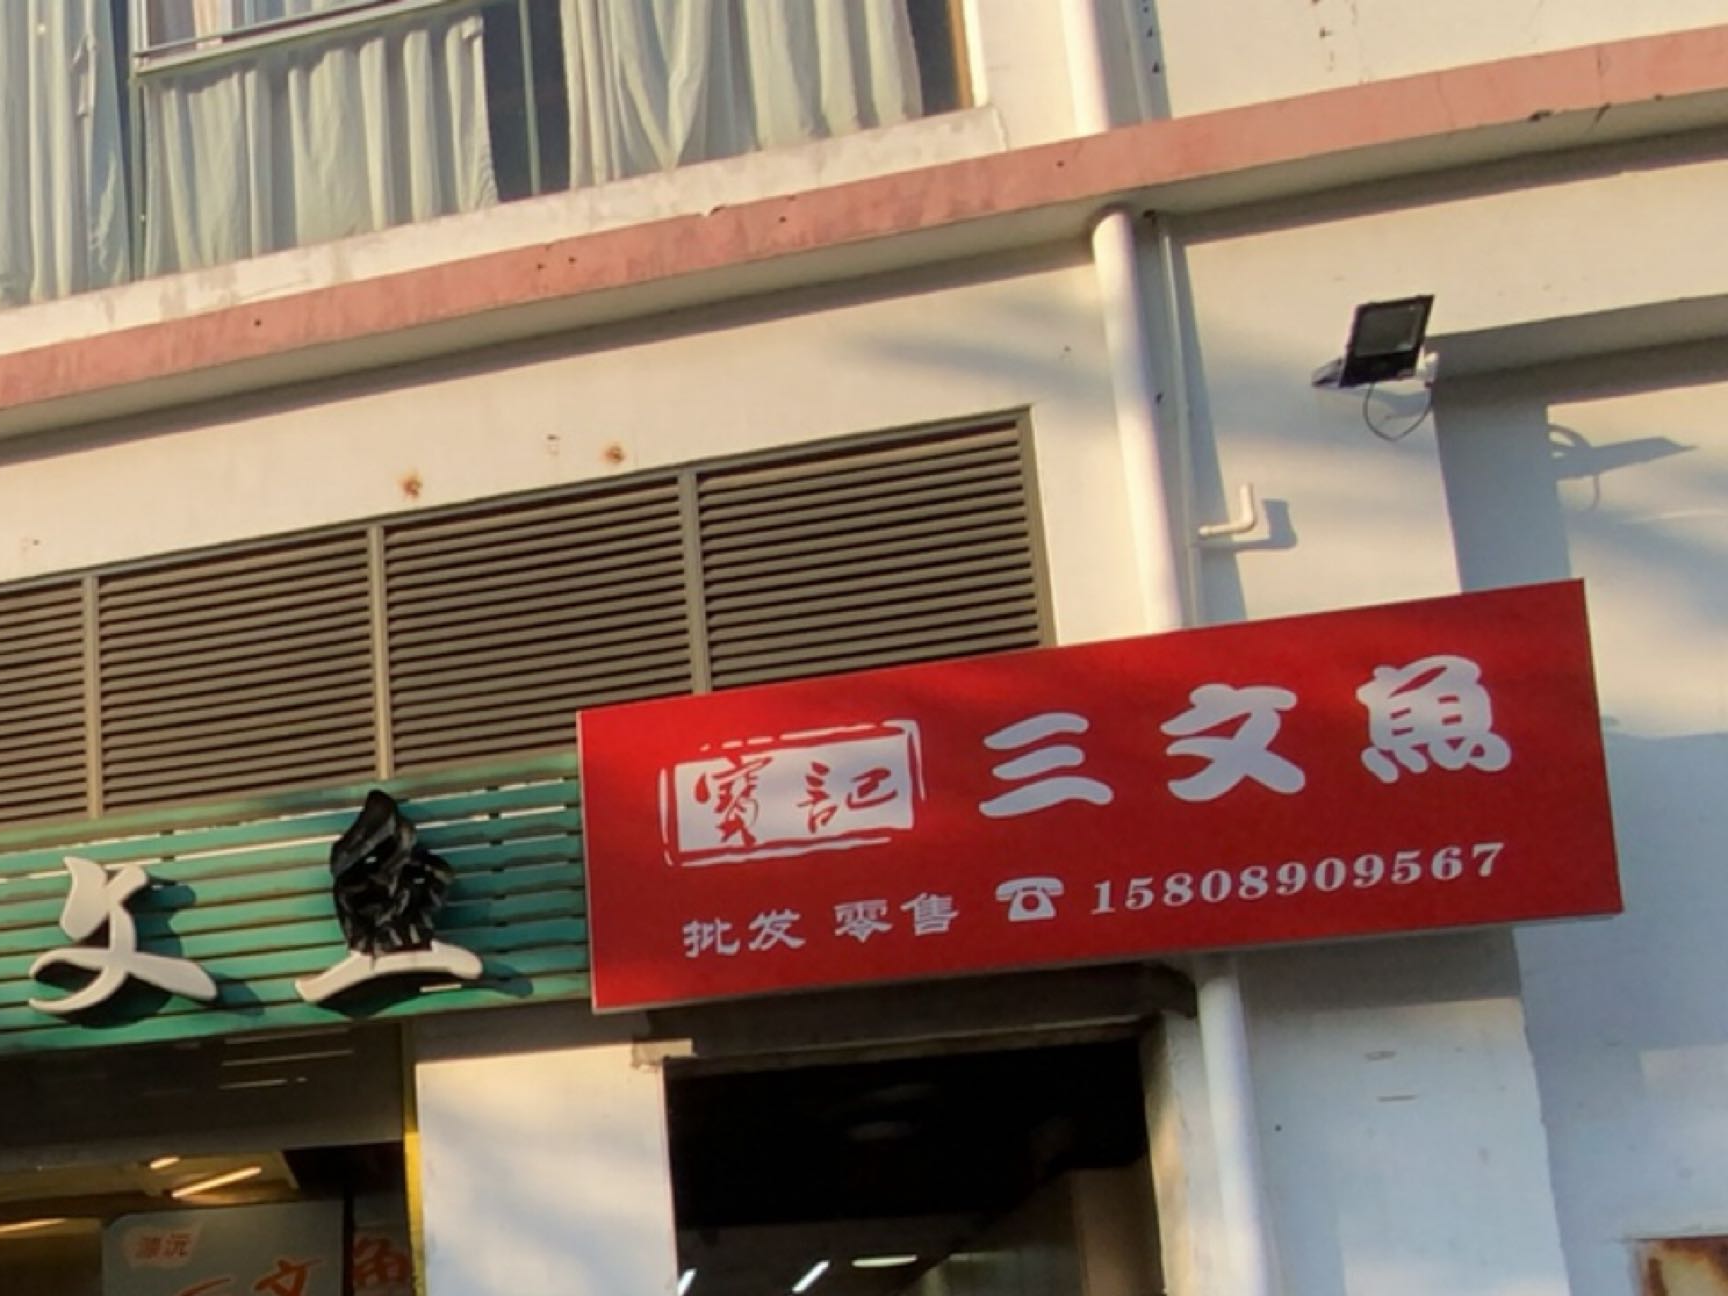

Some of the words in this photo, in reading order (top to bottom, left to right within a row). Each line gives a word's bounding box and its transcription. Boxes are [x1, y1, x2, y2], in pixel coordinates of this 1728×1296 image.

[979, 656, 1511, 815] 三文魚
[682, 908, 806, 959] 批发
[832, 890, 960, 942] 零售
[1090, 841, 1507, 917] 15808909567
